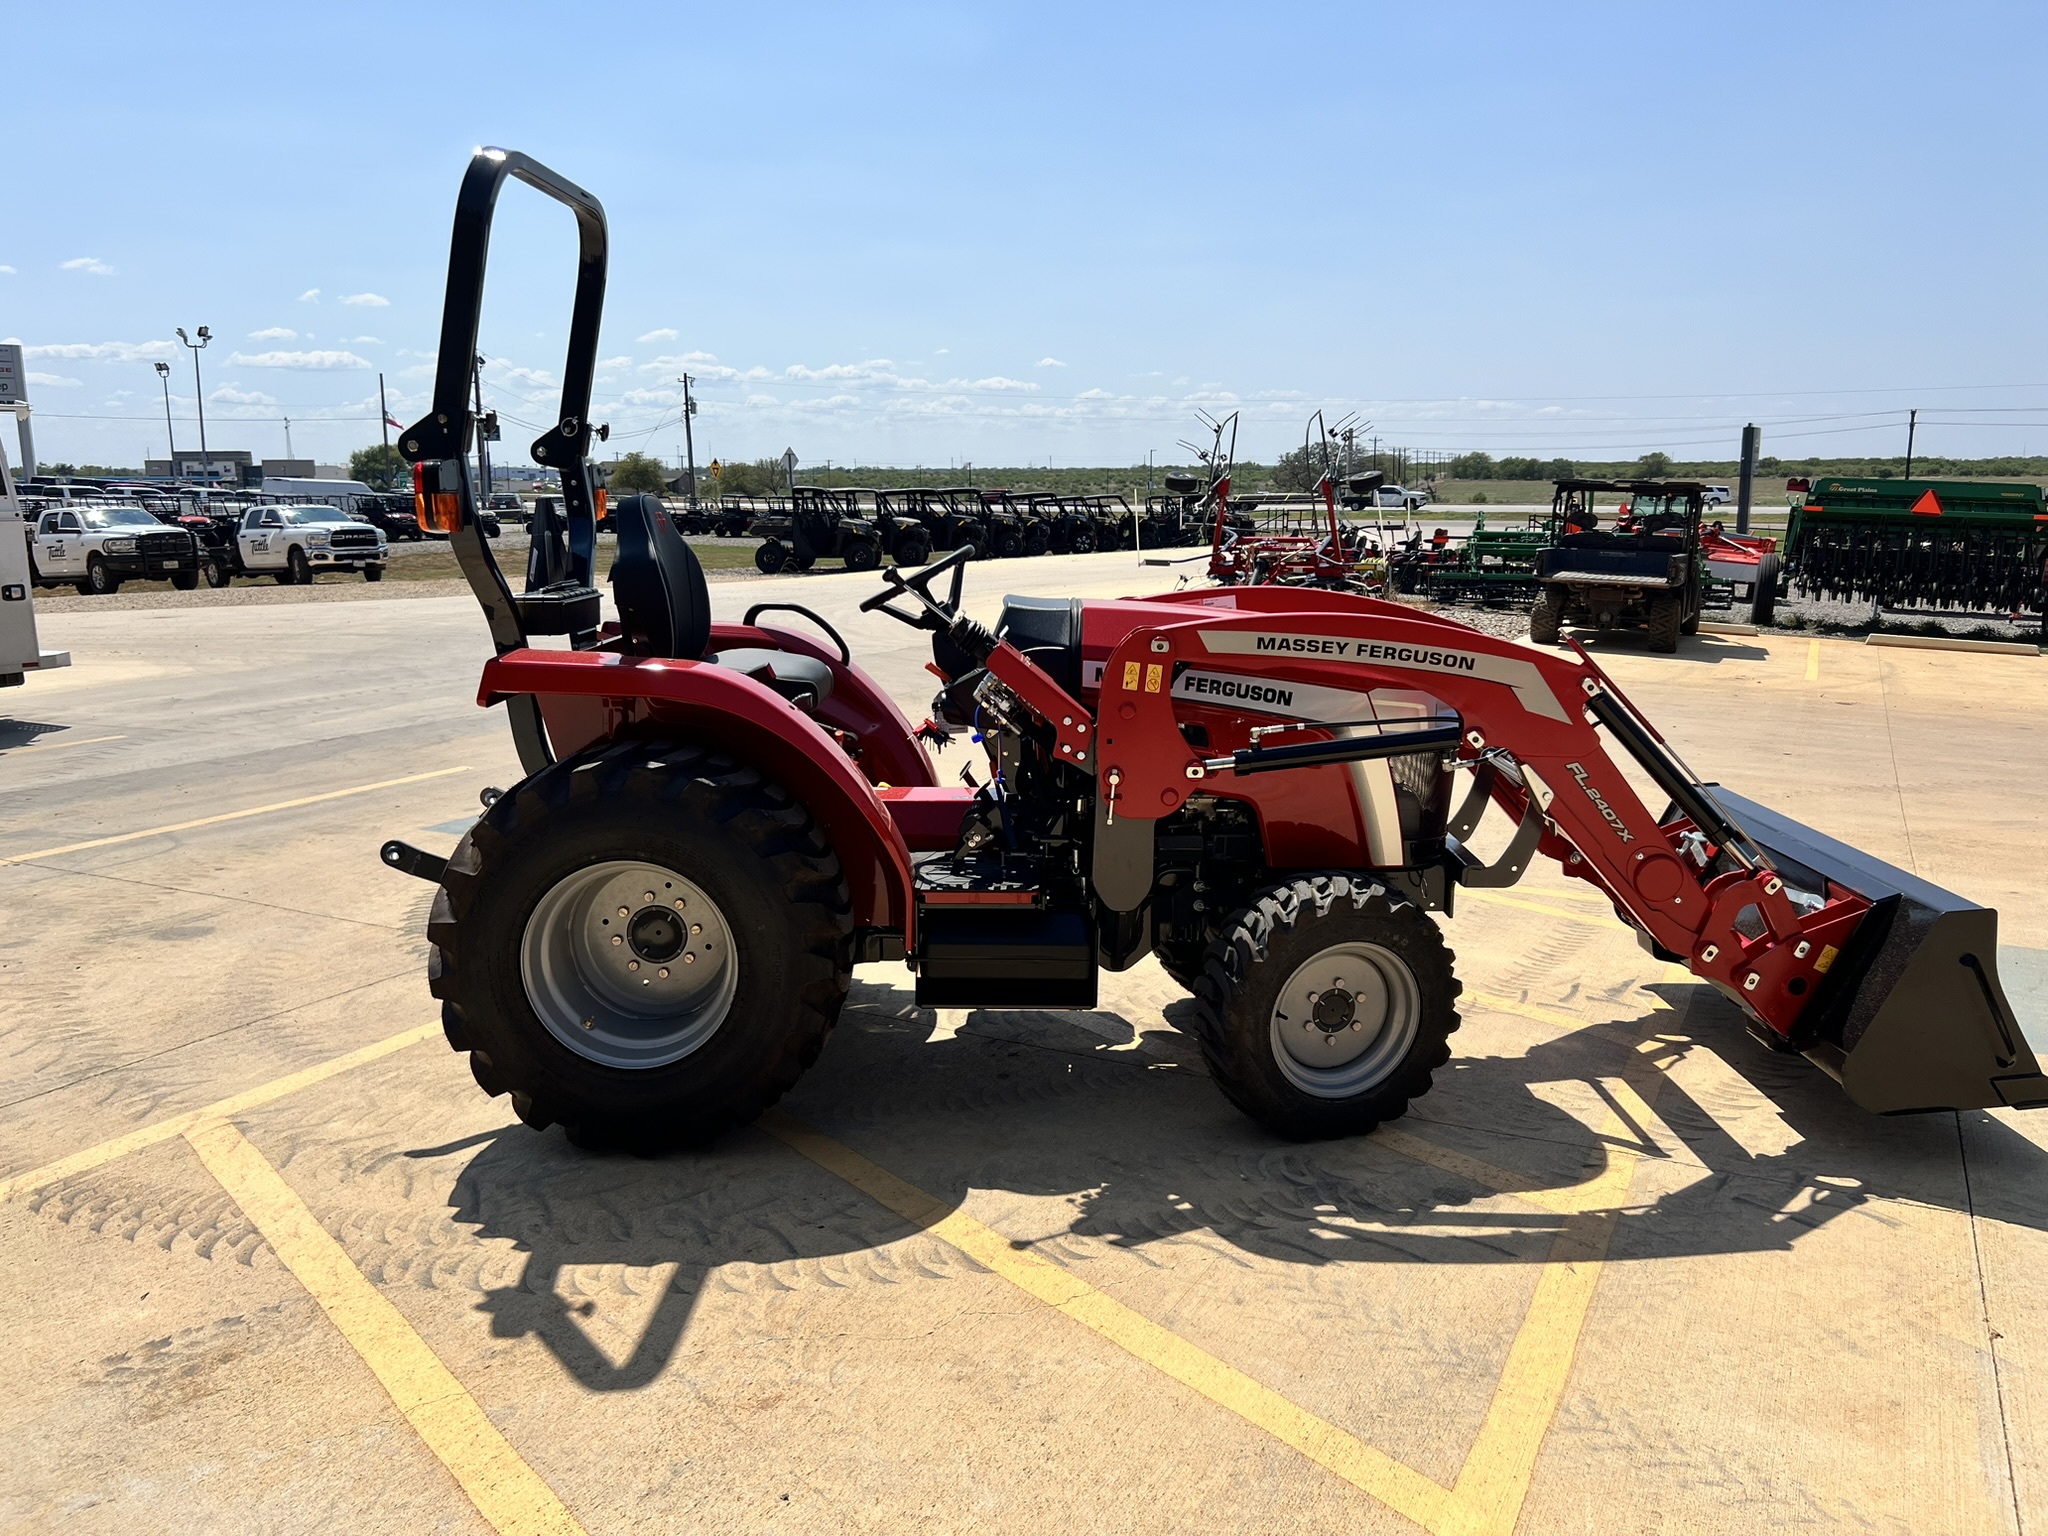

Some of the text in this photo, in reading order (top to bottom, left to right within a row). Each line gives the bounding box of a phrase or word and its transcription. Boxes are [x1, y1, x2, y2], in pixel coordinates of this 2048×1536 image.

[250, 538, 269, 556] Tuttle
[1256, 636, 1476, 671] MASSEY FERGUSON
[1184, 676, 1293, 707] FERGUSON
[1564, 762, 1636, 844] FL.2407X
